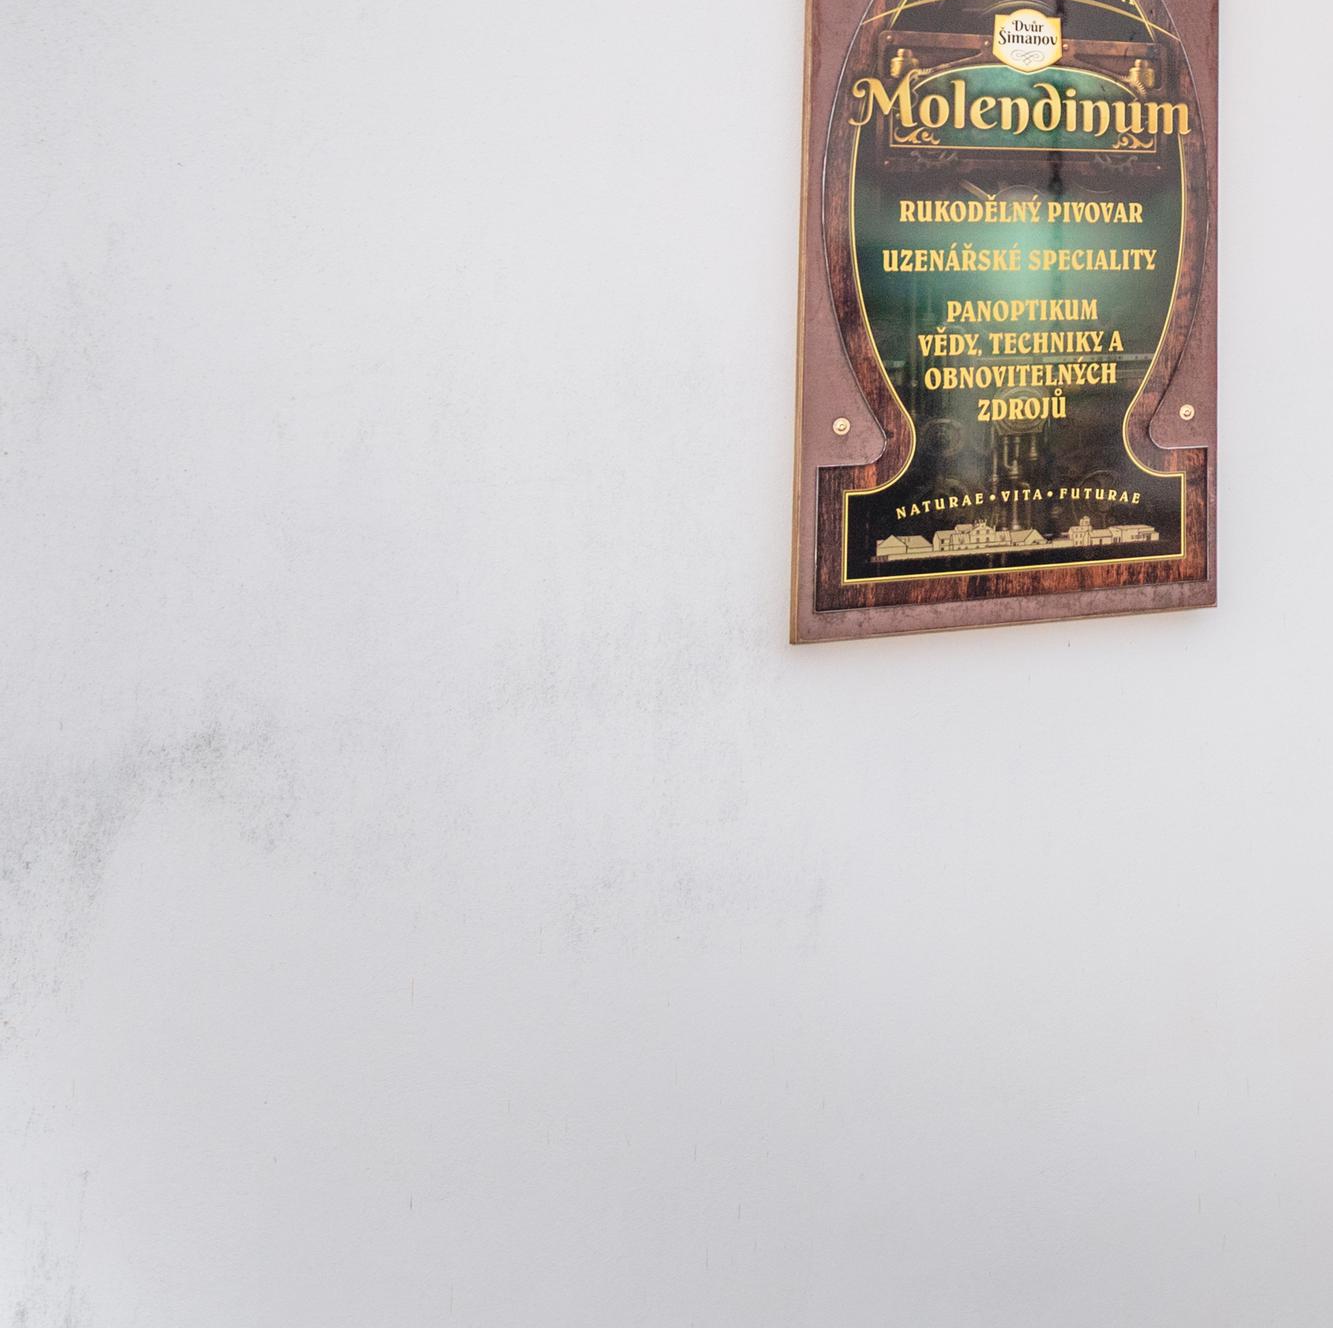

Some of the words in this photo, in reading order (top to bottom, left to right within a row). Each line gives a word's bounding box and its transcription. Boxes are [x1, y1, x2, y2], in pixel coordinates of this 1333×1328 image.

[998, 28, 1058, 48] Šimanov
[1011, 18, 1045, 34] Dvůr
[848, 68, 1192, 137] Molendinum
[899, 194, 1041, 224] RUKODĚLNÝ
[1048, 201, 1144, 224] PIVOVAR
[882, 243, 1021, 272] UZENÁŘSKÉ
[1028, 248, 1157, 272] SPECIALITY
[947, 298, 1098, 323] PANOPTIKUM
[918, 327, 983, 357] VĚDY,
[989, 331, 1104, 355] TECHNIKY
[1108, 330, 1124, 352] A
[924, 358, 1118, 390] OBNOVITELNÝCH
[977, 388, 1067, 422] ZDROJŮ
[896, 492, 985, 520] NATURAE
[1001, 488, 1043, 502] VITA
[1059, 487, 1141, 505] FUTURAE
